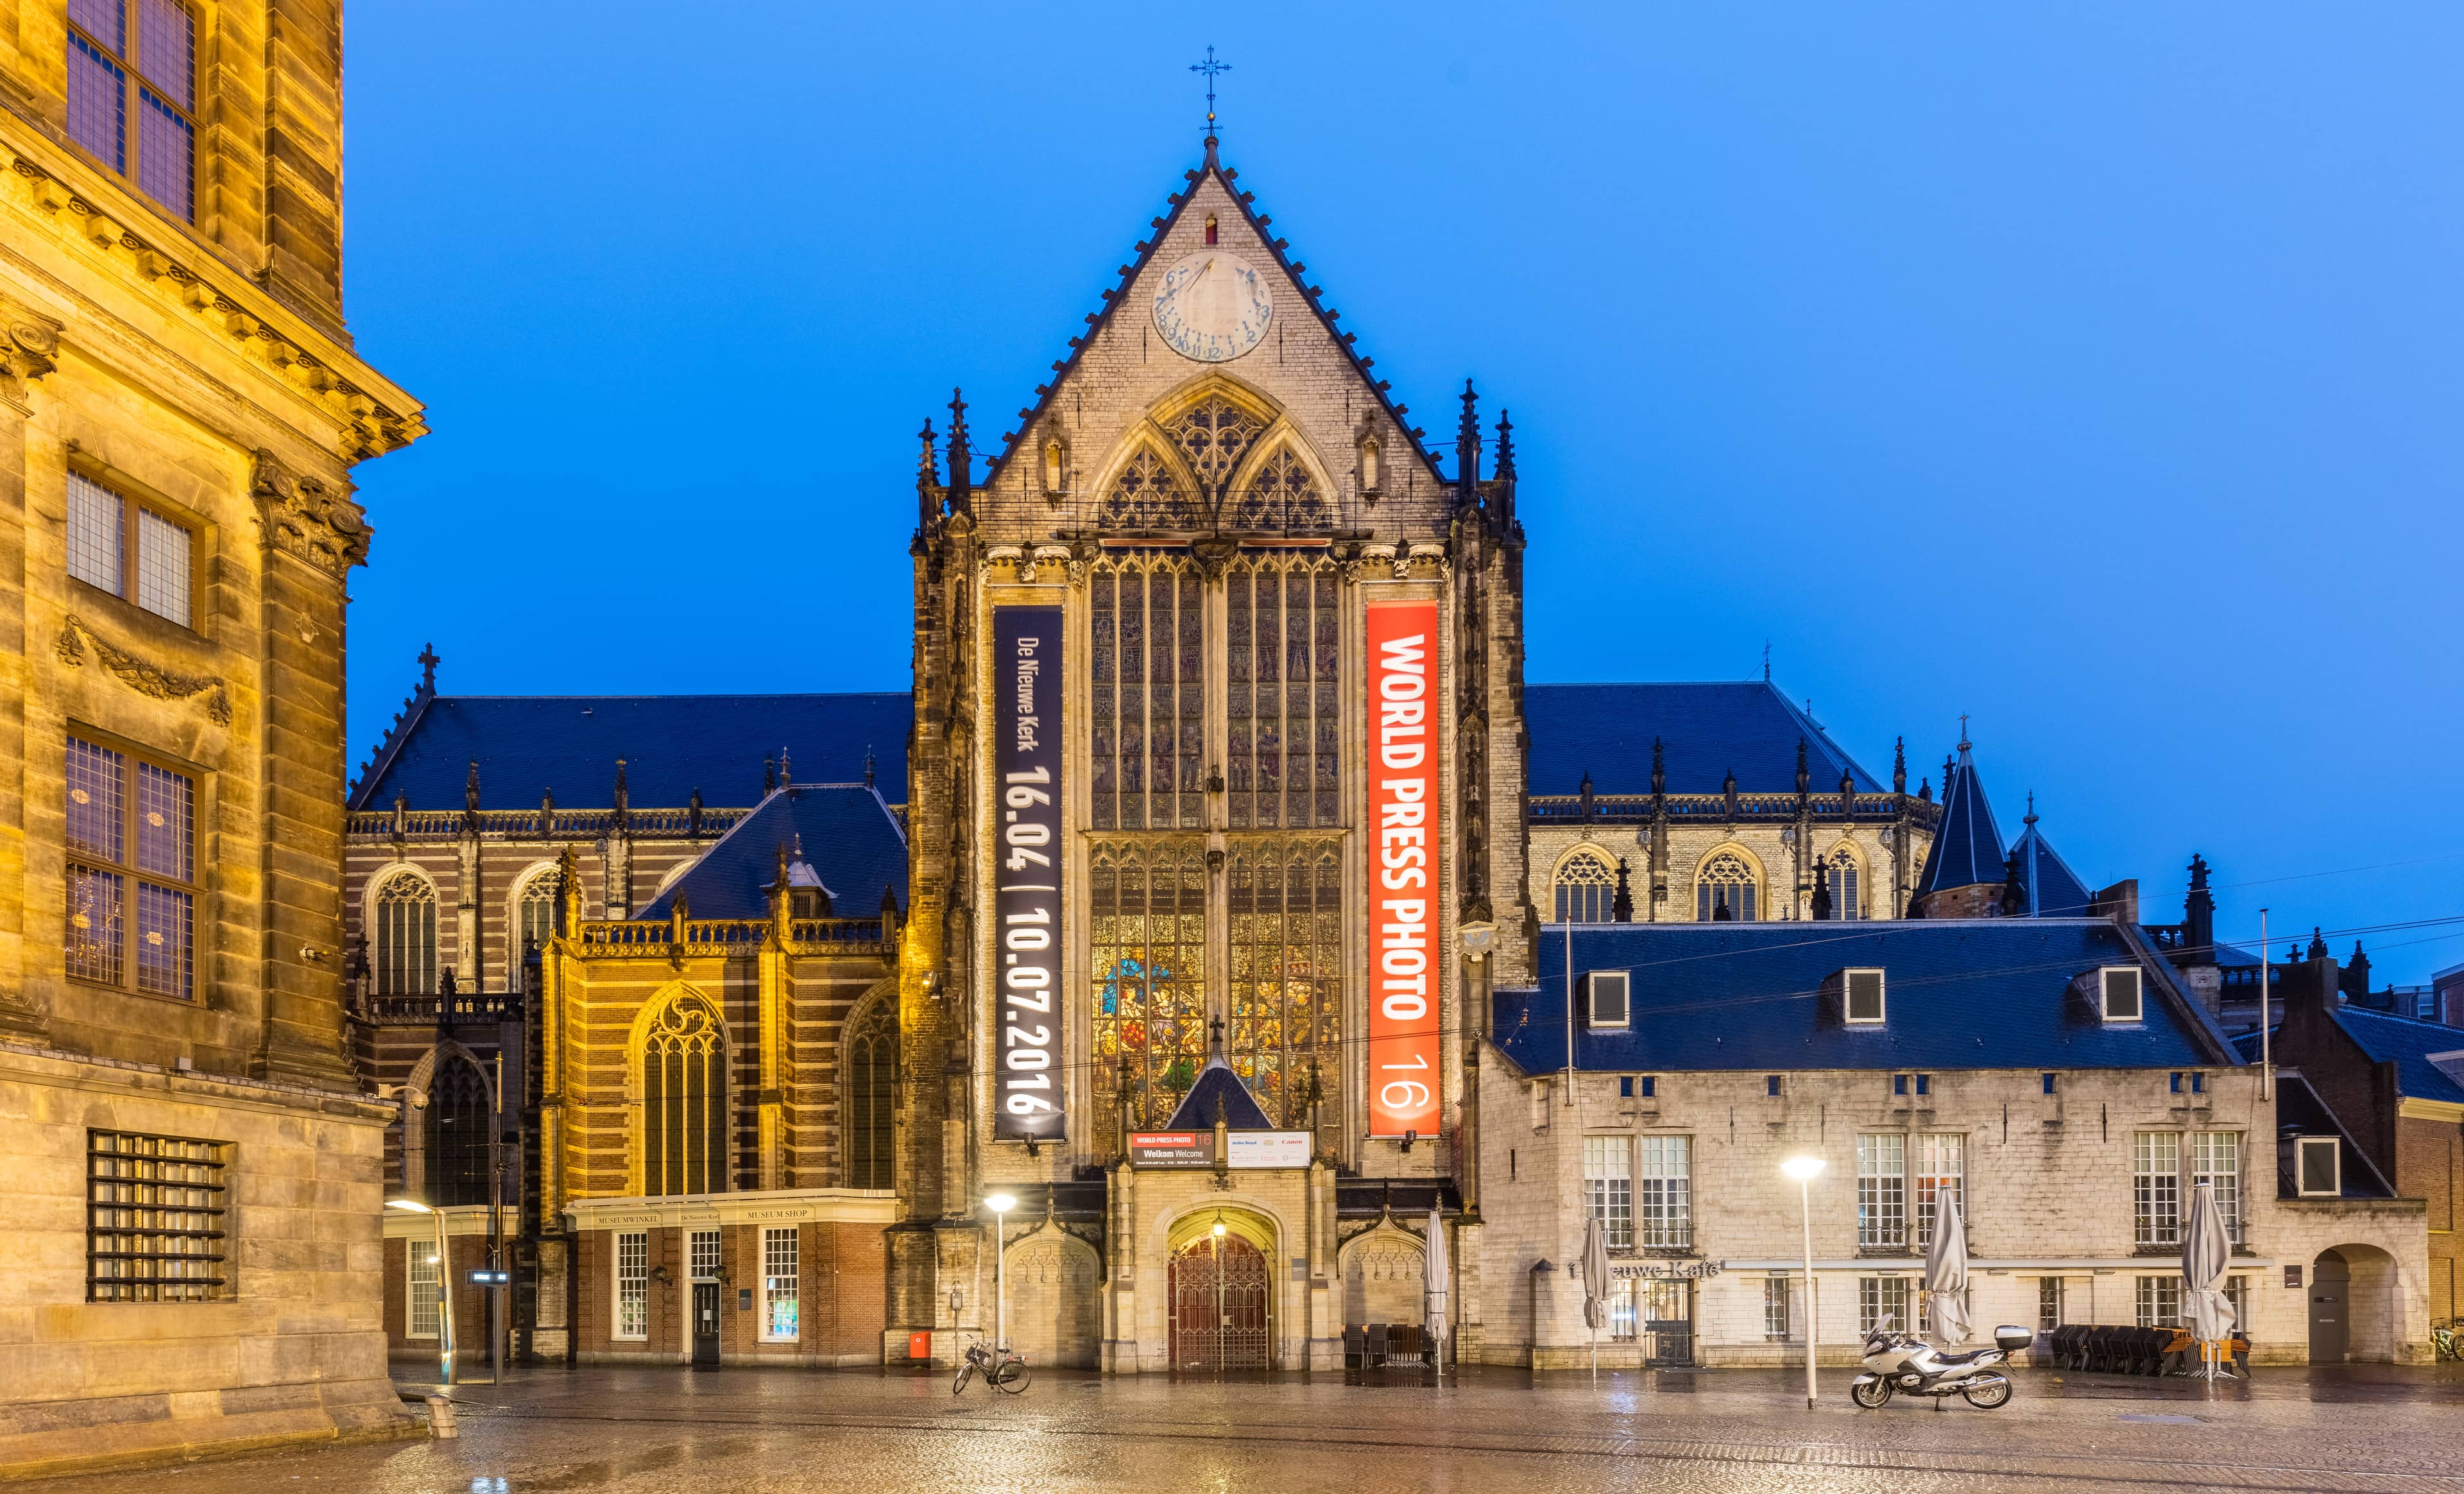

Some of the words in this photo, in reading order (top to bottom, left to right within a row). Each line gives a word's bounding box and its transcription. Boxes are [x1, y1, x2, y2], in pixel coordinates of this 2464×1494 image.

[1166, 271, 1176, 284] 6
[1245, 268, 1255, 282] 4
[1158, 314, 1167, 330] 8
[1168, 327, 1176, 340] 9
[1246, 331, 1256, 342] 2
[1205, 347, 1220, 359] 12
[1018, 638, 1039, 656] De
[1018, 660, 1039, 714] Nieuwe
[1380, 633, 1425, 769] WORLD
[1018, 716, 1039, 752] Kerk
[1005, 766, 1050, 871] 16.04
[1381, 777, 1426, 890] PRESS
[1382, 898, 1427, 1020] PHOTO
[1005, 908, 1050, 1115] 10.07.2016
[1381, 1054, 1429, 1109] 16
[1196, 1134, 1211, 1146] 16
[1143, 1149, 1174, 1158] Welkom
[1175, 1149, 1203, 1158] Welcome
[599, 1215, 658, 1224] MUSEUMWINKEL
[748, 1211, 783, 1219] MUSEUM
[785, 1210, 807, 1218] SHOP
[1611, 1265, 1663, 1278] euwe
